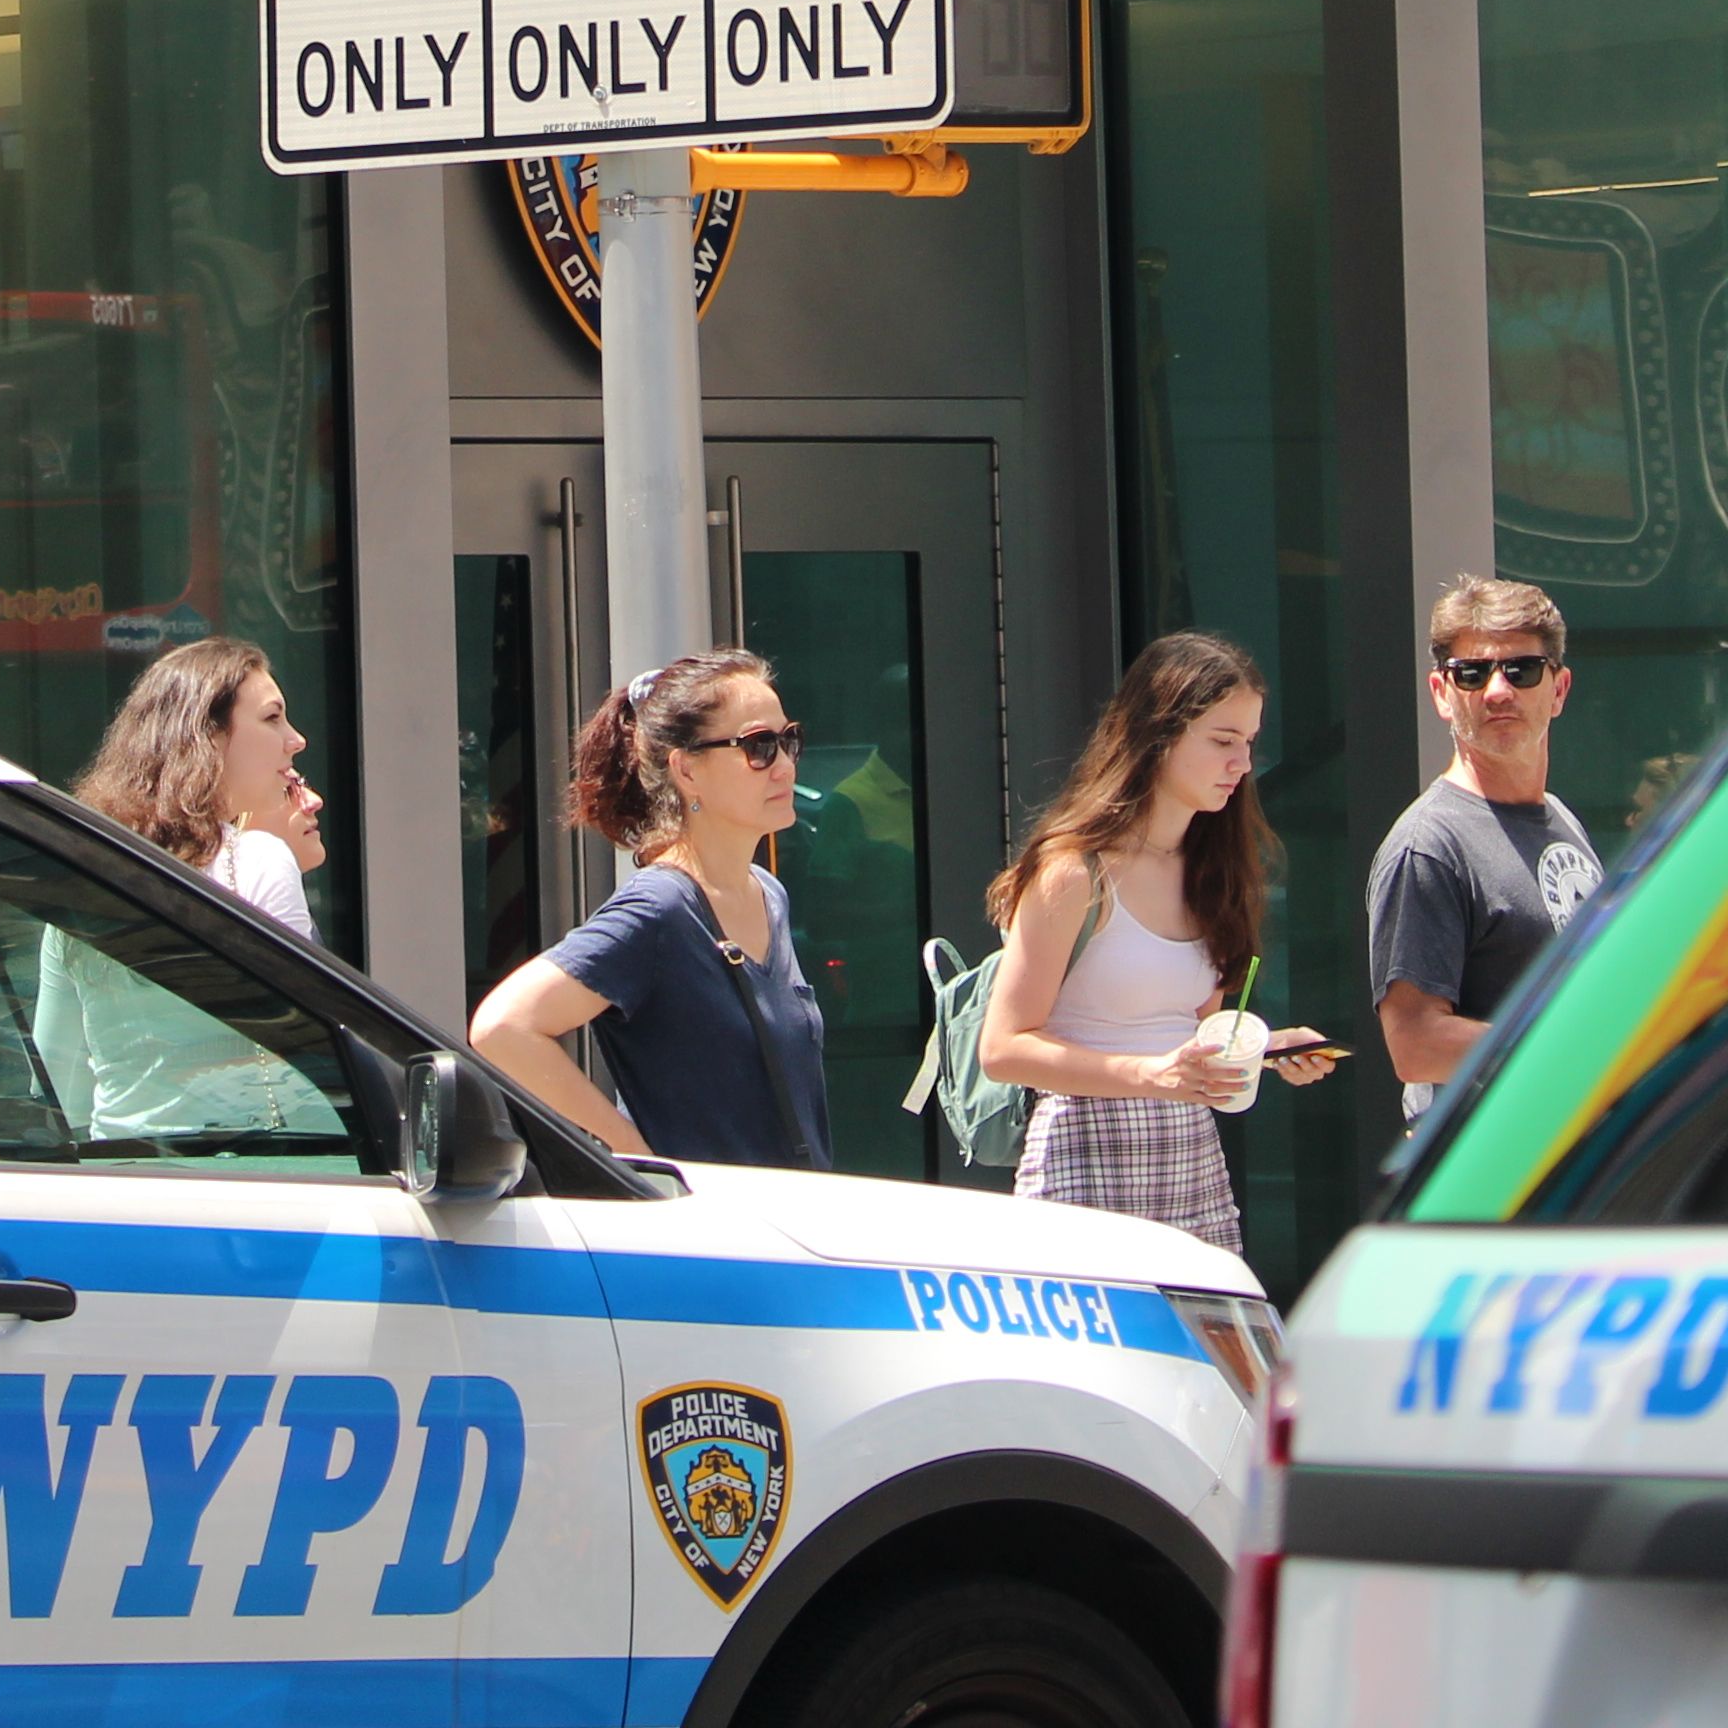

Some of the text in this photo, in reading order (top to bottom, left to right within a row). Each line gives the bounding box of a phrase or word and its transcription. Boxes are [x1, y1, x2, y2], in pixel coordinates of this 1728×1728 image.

[297, 30, 470, 118] ONLY
[508, 14, 687, 103] ONLY
[543, 123, 565, 133] DEPT
[581, 117, 657, 130] TRANSPORTATION
[520, 158, 571, 242] CITY
[559, 253, 602, 301] OF
[693, 237, 719, 300] EW
[904, 1268, 1115, 1348] POLICE
[648, 1415, 780, 1459] DEPARTMENT
[670, 1392, 749, 1420] POLICE
[654, 1484, 711, 1570] CITY OF
[736, 1464, 786, 1579] NEW YORK
